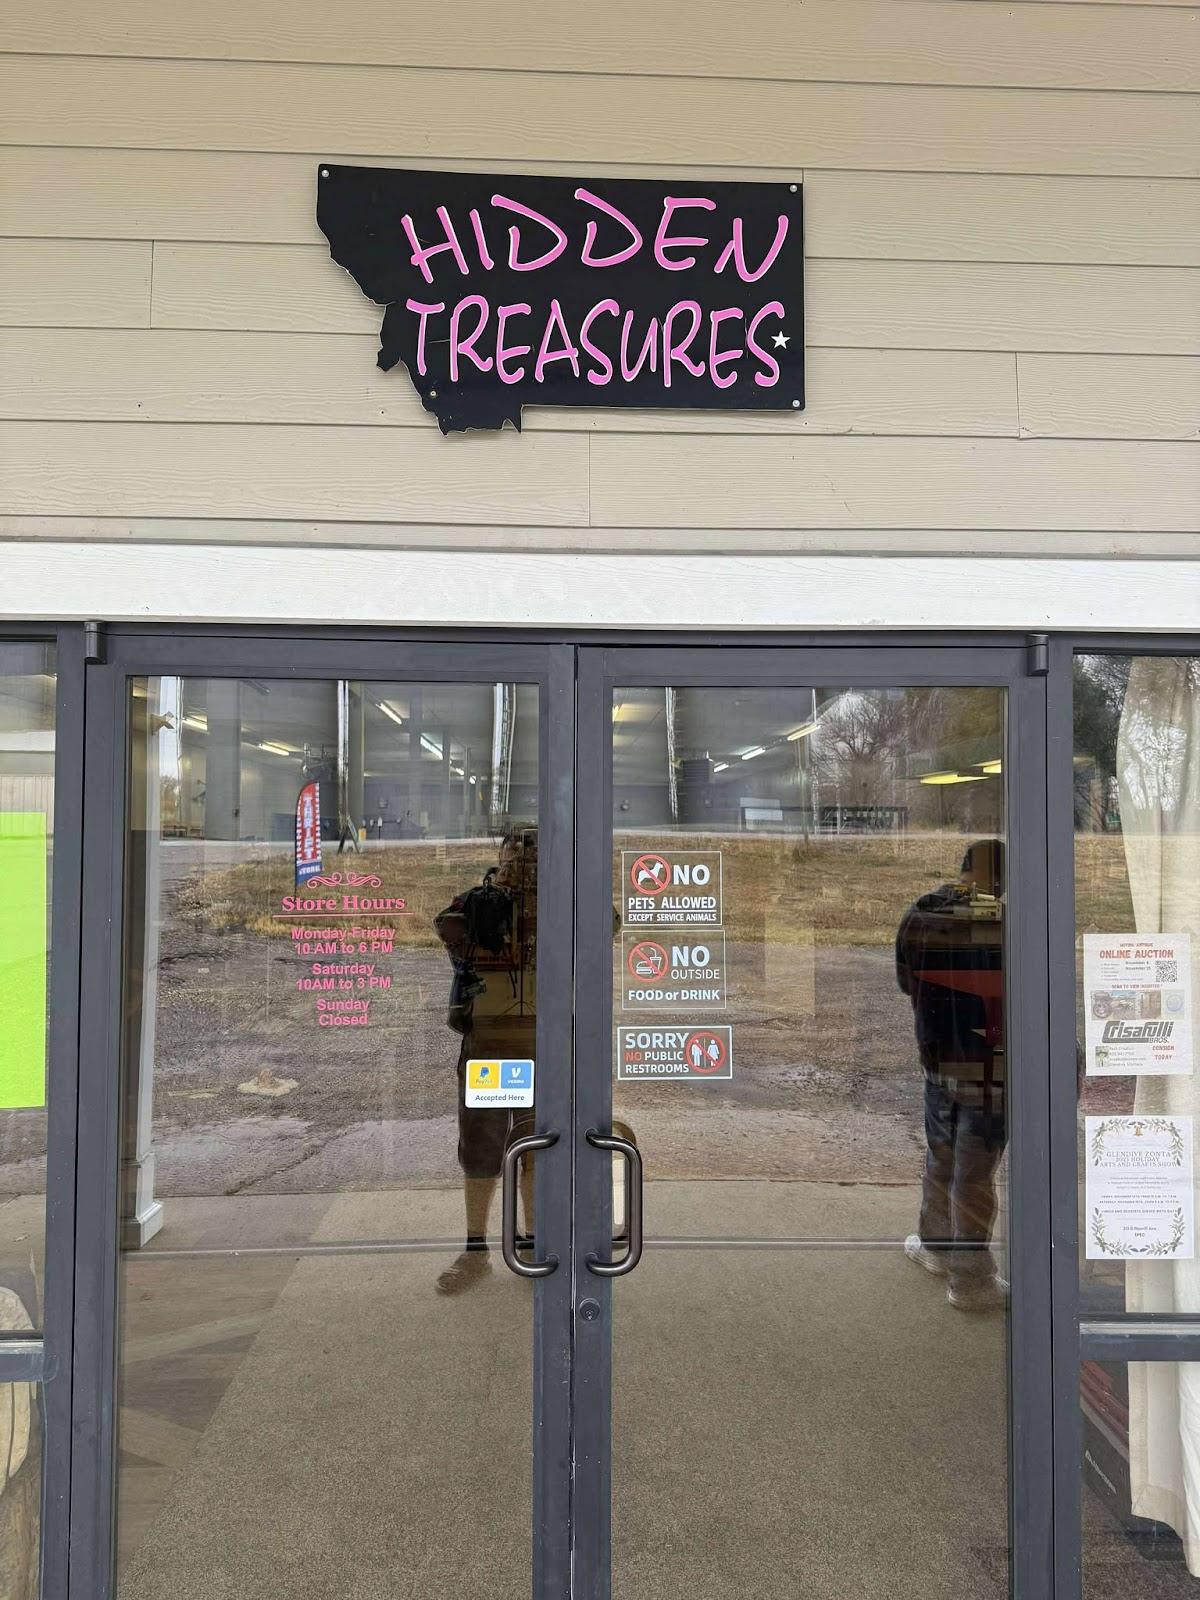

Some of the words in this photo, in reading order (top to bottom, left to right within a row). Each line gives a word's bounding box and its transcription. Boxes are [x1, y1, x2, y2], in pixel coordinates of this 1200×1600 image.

[401, 188, 789, 283] HIDDEN
[405, 294, 785, 388] TREASURES
[672, 864, 710, 886] NO
[282, 896, 336, 912] Store
[342, 895, 406, 911] Hours
[628, 897, 655, 910] PETS
[661, 896, 717, 909] ALLOWED
[628, 913, 654, 922] EXCEPT
[656, 913, 684, 922] SERVICE
[686, 913, 717, 921] ANIMALS
[291, 927, 396, 941] Monday-Friday
[341, 943, 355, 954] to
[358, 942, 368, 953] 6
[371, 941, 393, 953] PM
[1099, 949, 1132, 959] ONLINE
[1135, 949, 1174, 959] AUCTION
[672, 946, 710, 967] NO
[312, 962, 375, 976] Saturday
[671, 969, 720, 980] OUTSIDE
[339, 978, 353, 989] to
[357, 977, 365, 989] 3
[369, 976, 391, 988] PM
[628, 990, 664, 1001] FOOD
[665, 991, 679, 1001] or
[681, 989, 720, 1000] DRINK
[316, 998, 370, 1012] Sunday
[318, 1013, 368, 1026] Closed
[625, 1032, 690, 1049] SORRY
[625, 1052, 642, 1061] NO
[645, 1051, 684, 1061] PUBLIC
[625, 1063, 690, 1074] RESTROOMS
[475, 1094, 507, 1102] Accepted
